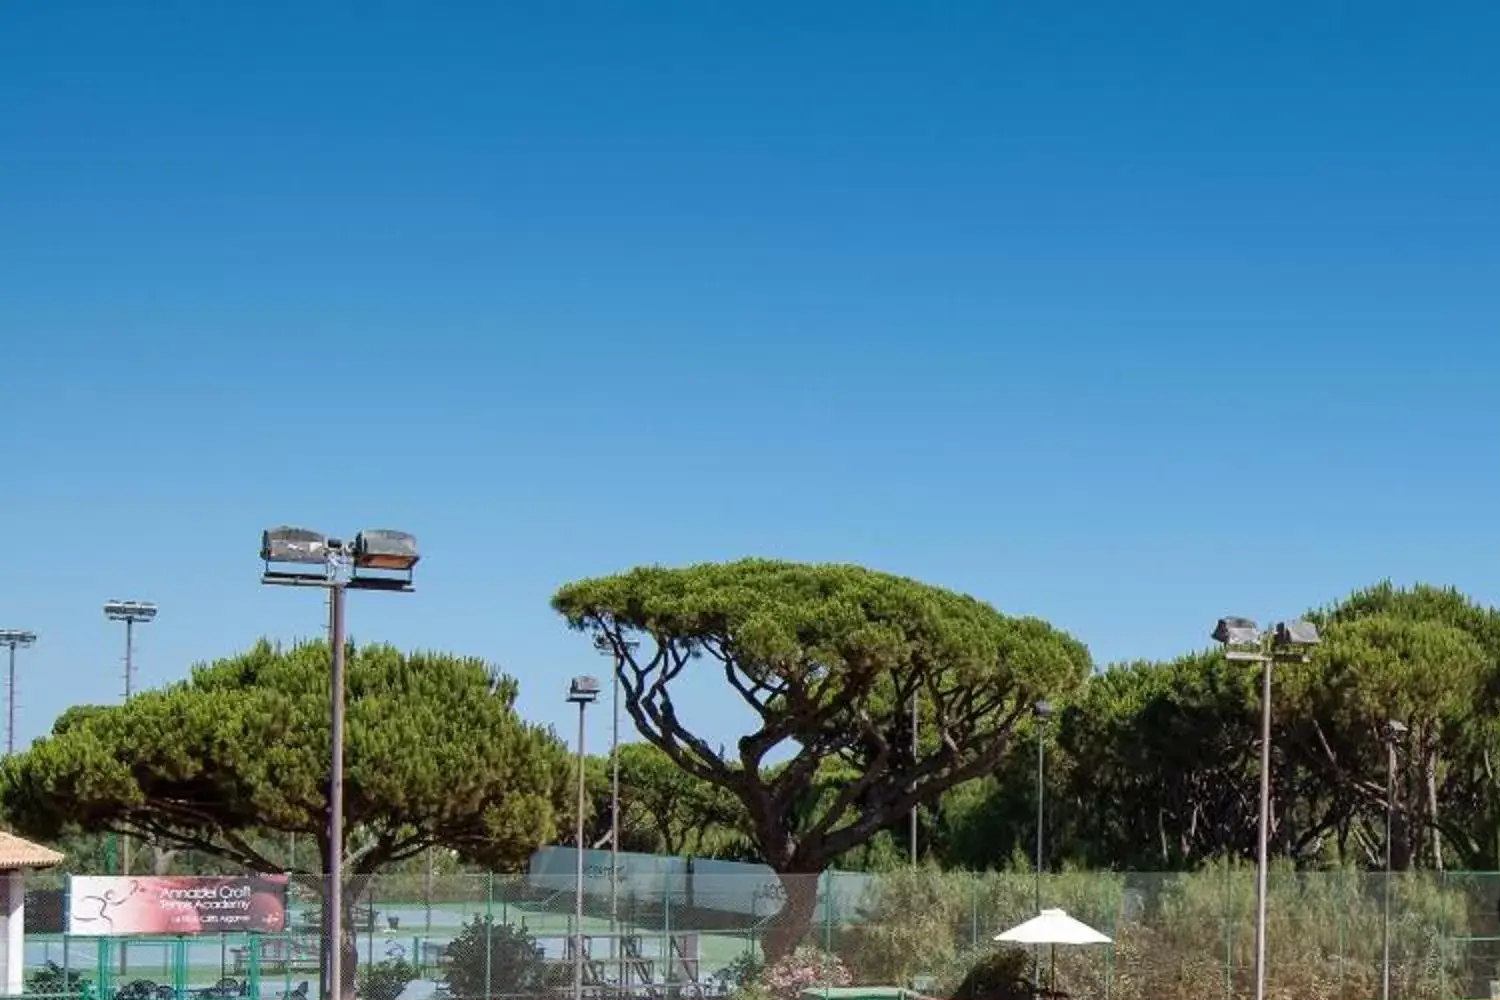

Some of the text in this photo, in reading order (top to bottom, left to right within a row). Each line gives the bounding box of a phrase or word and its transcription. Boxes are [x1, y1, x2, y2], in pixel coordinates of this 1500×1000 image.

[159, 885, 251, 899] Annabel Croft
[194, 899, 251, 911] Academy
